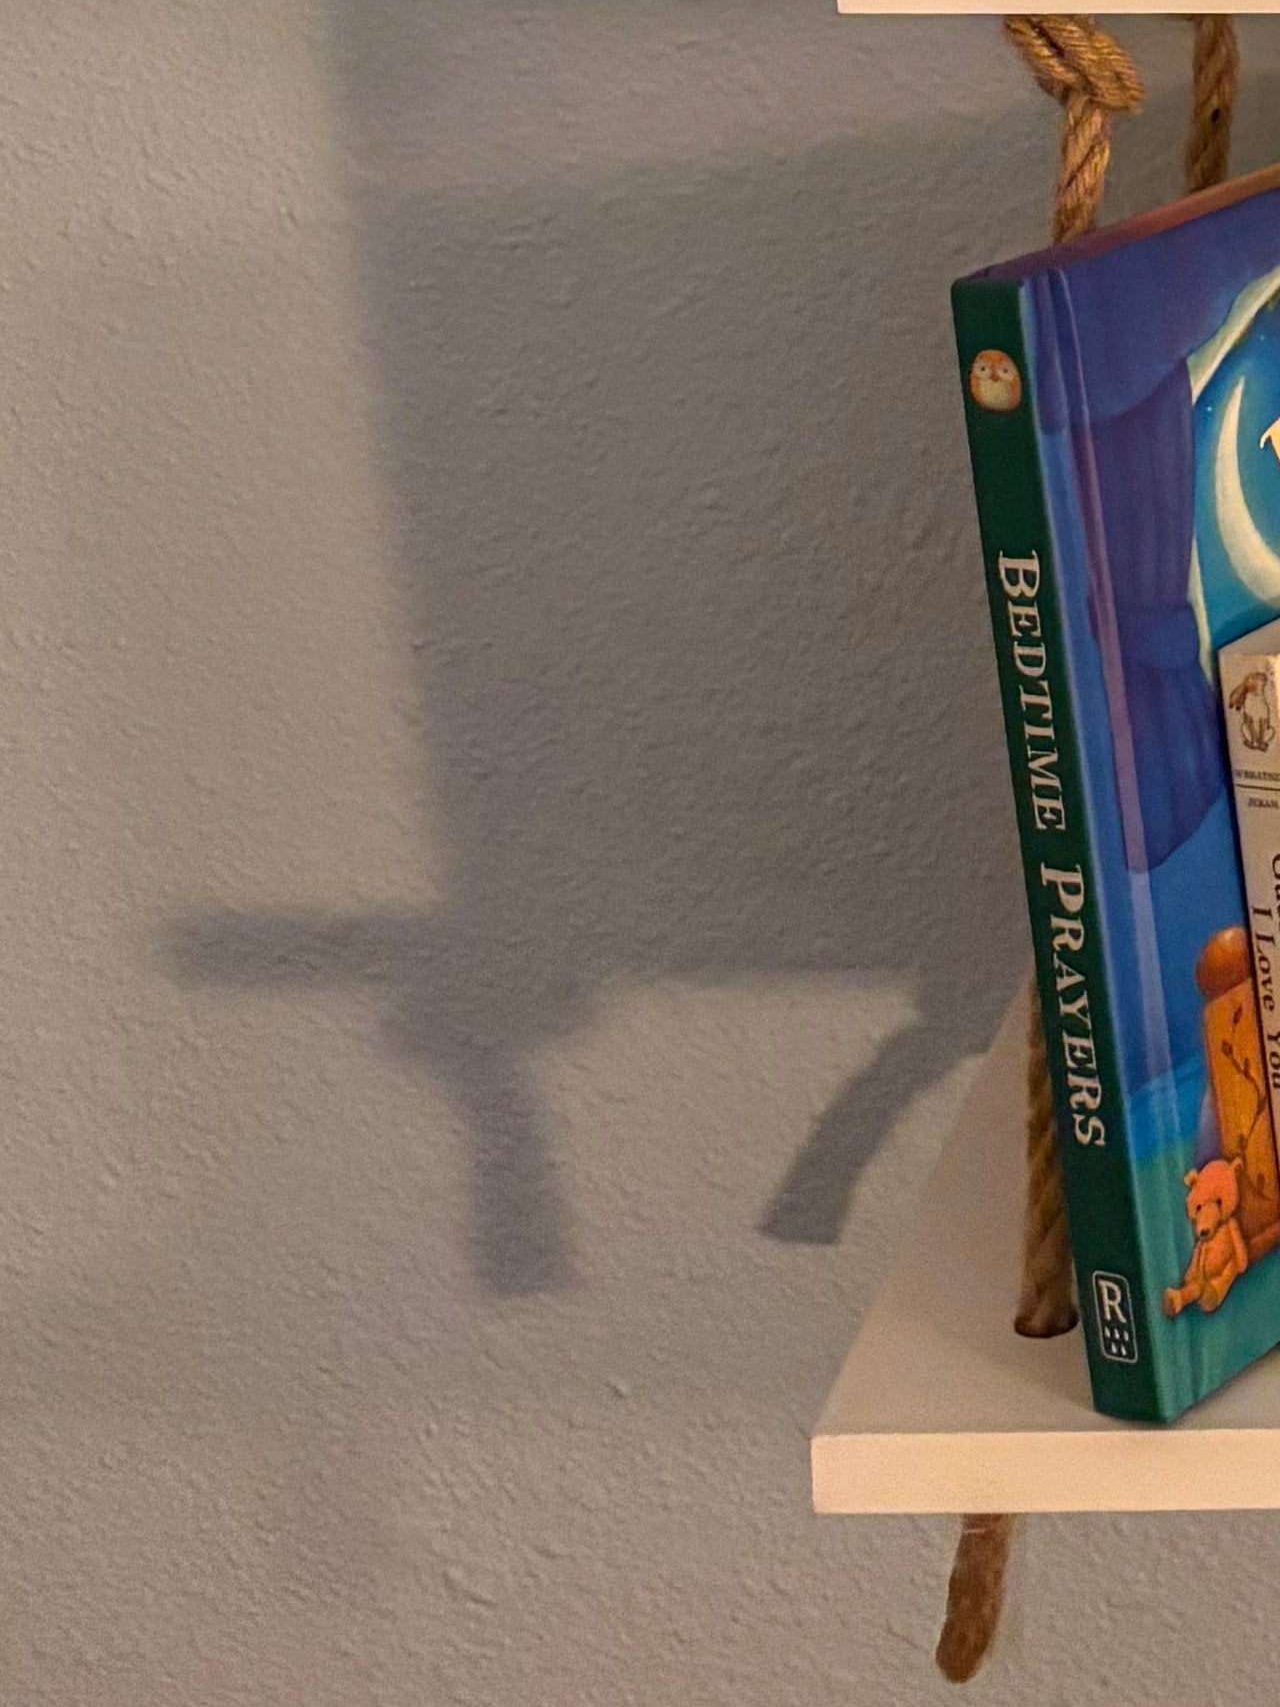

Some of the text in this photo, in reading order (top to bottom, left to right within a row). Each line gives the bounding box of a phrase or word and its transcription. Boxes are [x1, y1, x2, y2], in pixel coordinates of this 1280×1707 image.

[999, 549, 1106, 1147] BEDTIME PRAYERS
[1252, 906, 1273, 919] I
[1255, 933, 1277, 1013] Love
